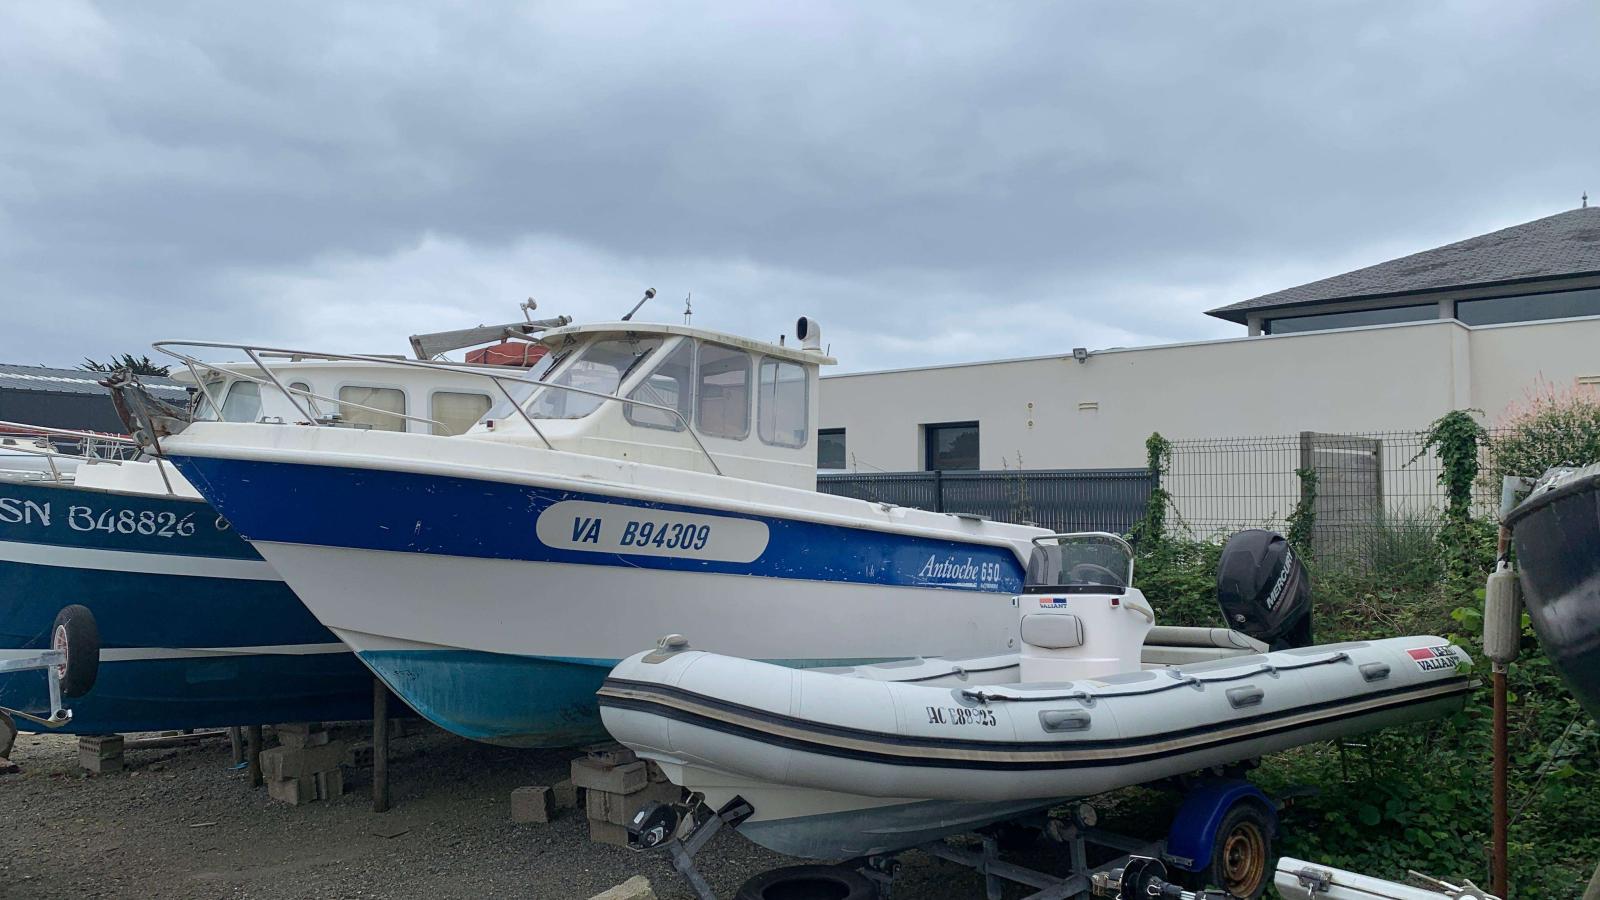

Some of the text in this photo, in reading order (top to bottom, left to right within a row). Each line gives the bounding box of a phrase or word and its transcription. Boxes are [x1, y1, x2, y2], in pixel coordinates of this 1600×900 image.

[0, 497, 196, 538] SN B48826
[571, 516, 711, 550] VA B94309
[918, 554, 1000, 582] Antioche 650
[1266, 546, 1293, 609] MERCURY
